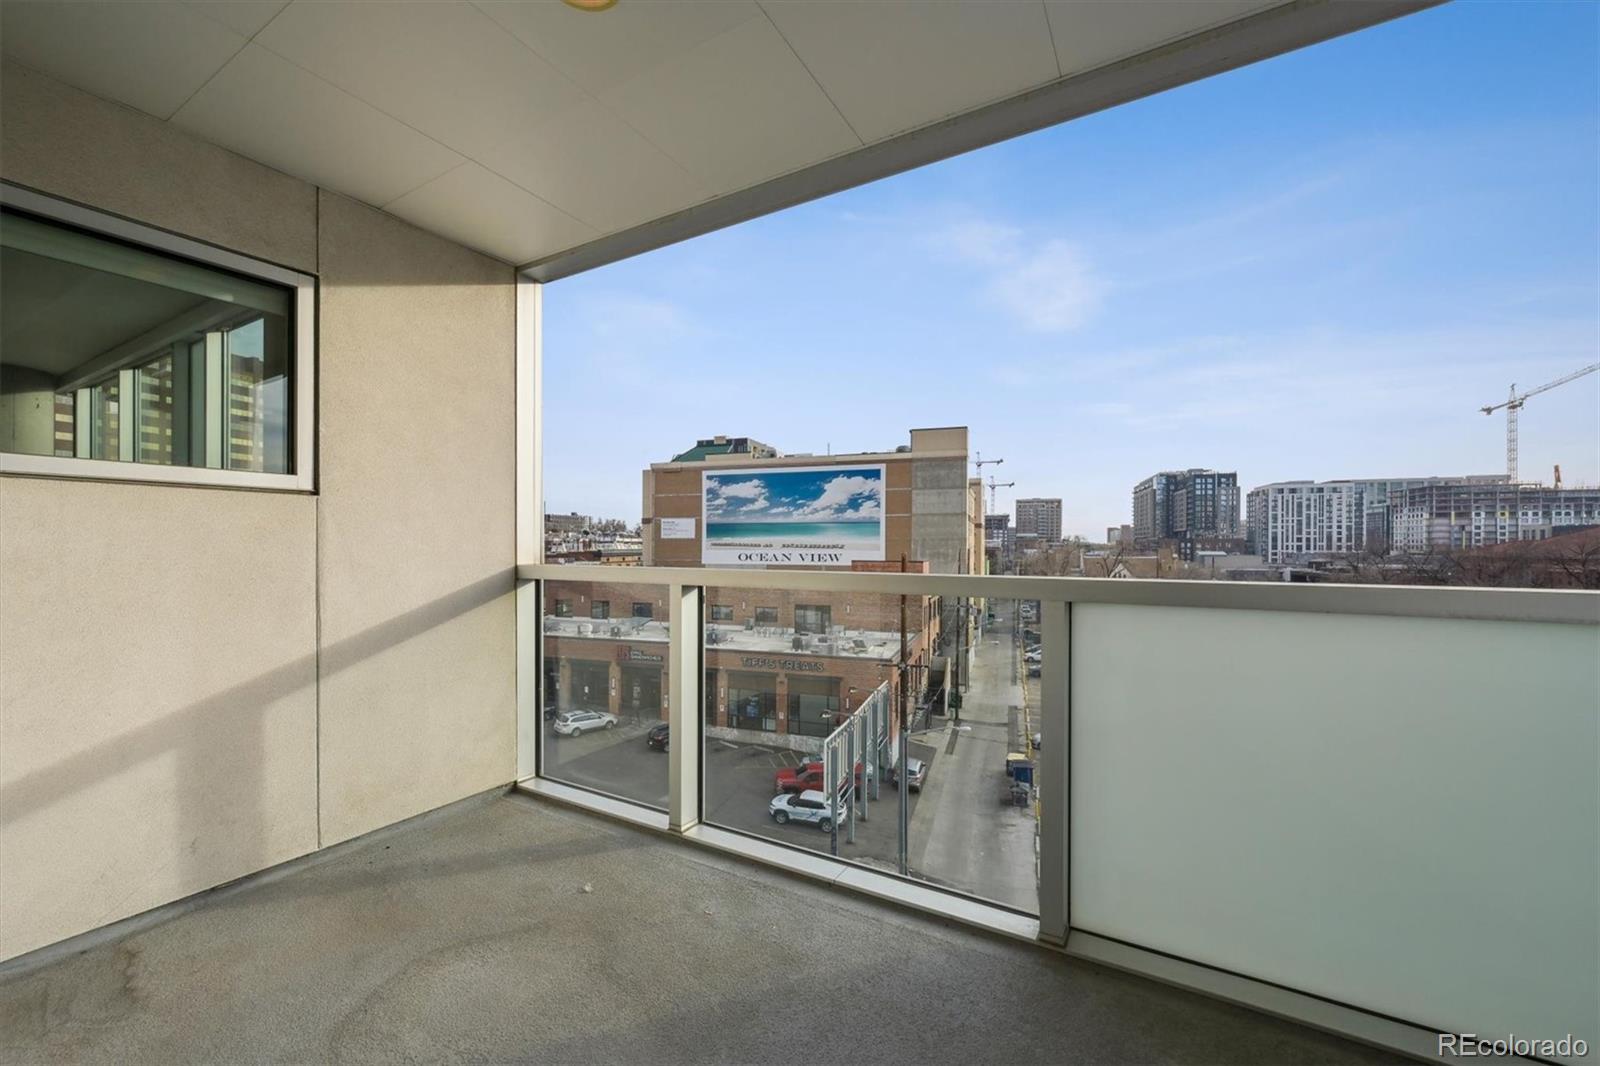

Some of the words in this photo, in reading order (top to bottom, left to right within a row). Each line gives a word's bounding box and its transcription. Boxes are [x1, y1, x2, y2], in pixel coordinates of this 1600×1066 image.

[738, 553, 792, 562] OCEAN
[799, 553, 842, 562] VIEW
[779, 660, 824, 672] TREATS
